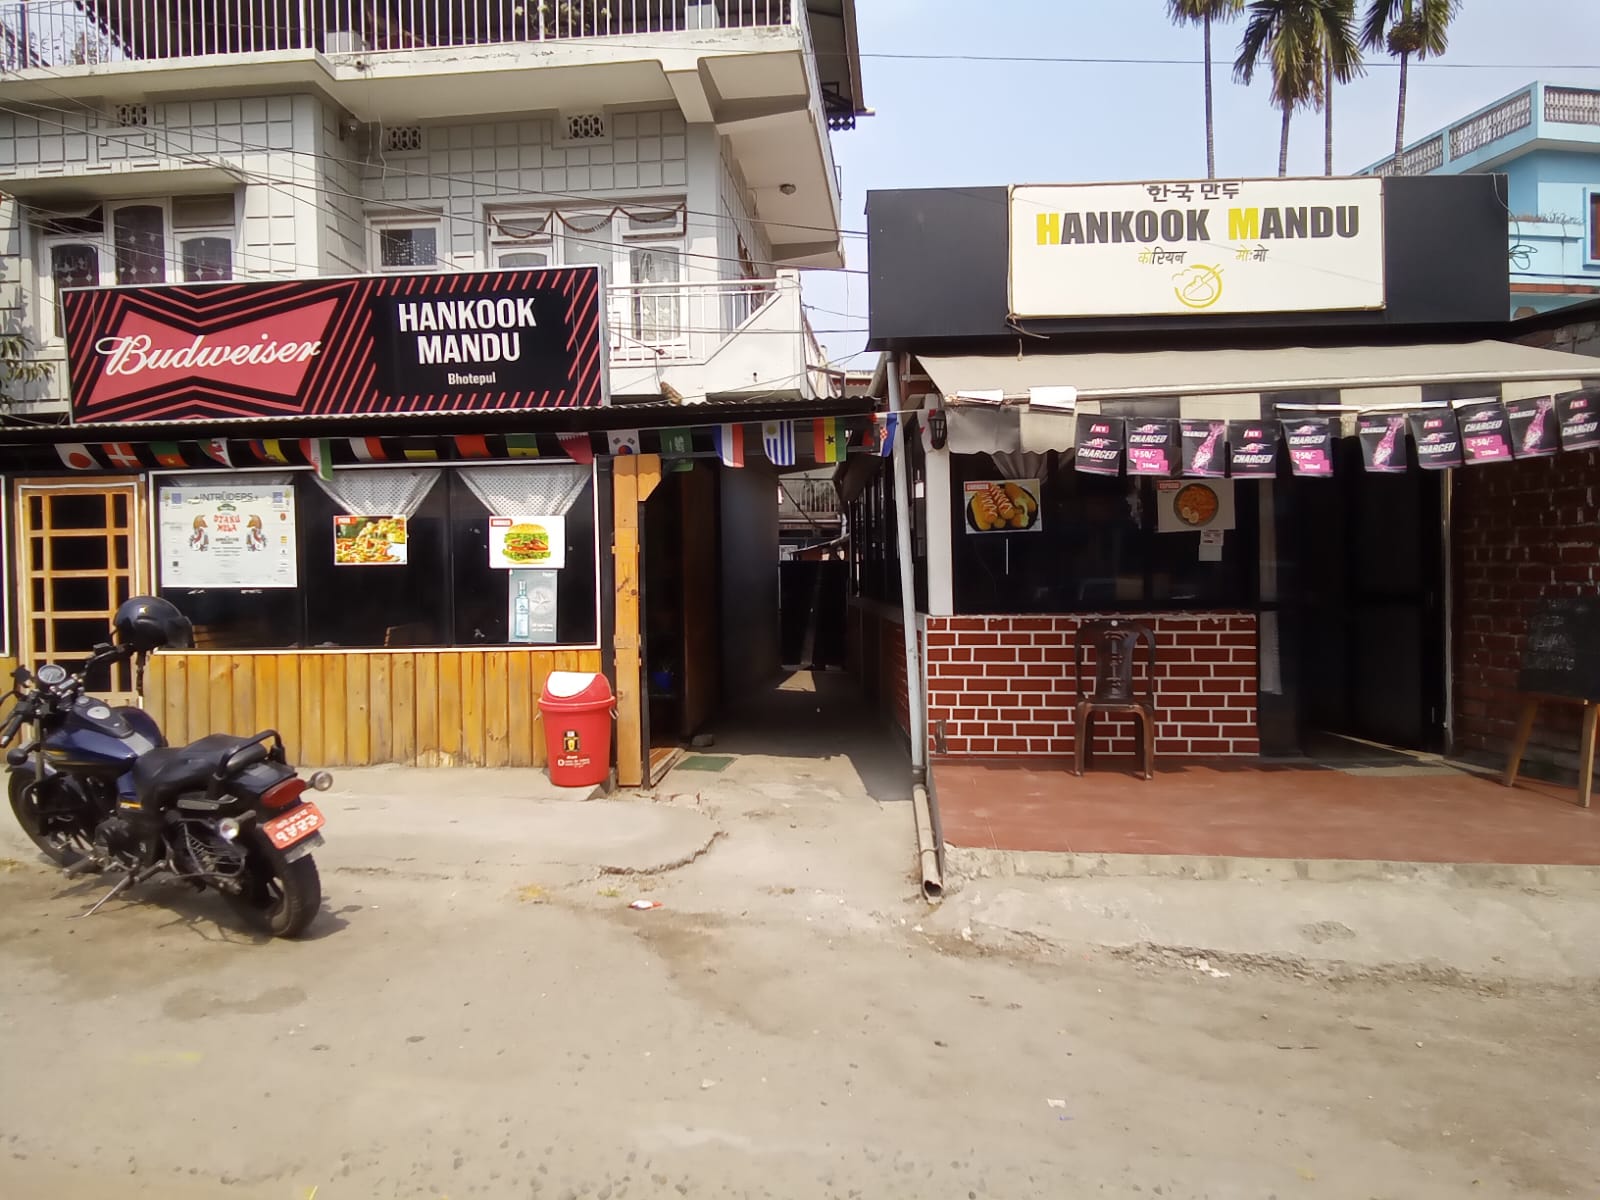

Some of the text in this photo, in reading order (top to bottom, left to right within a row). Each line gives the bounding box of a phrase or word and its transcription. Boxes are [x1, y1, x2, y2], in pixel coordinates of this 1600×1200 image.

[1146, 182, 1240, 202] 한국 만두
[1036, 205, 1359, 245] HANKOOK MANDU
[1138, 246, 1187, 265] कोरियन
[398, 297, 537, 332] HANKOOK
[95, 333, 321, 376] Budweiser
[417, 332, 521, 365] MANDU
[448, 371, 496, 386] Bhotepul
[1465, 420, 1503, 432] CHARGED
[1562, 422, 1598, 436] CHARGED
[1129, 435, 1168, 443] CHARGED
[1289, 435, 1326, 444] CHARGED
[1078, 448, 1118, 459] CHARGED
[1418, 442, 1456, 454] CHARGED
[1233, 455, 1273, 464] CHARGED
